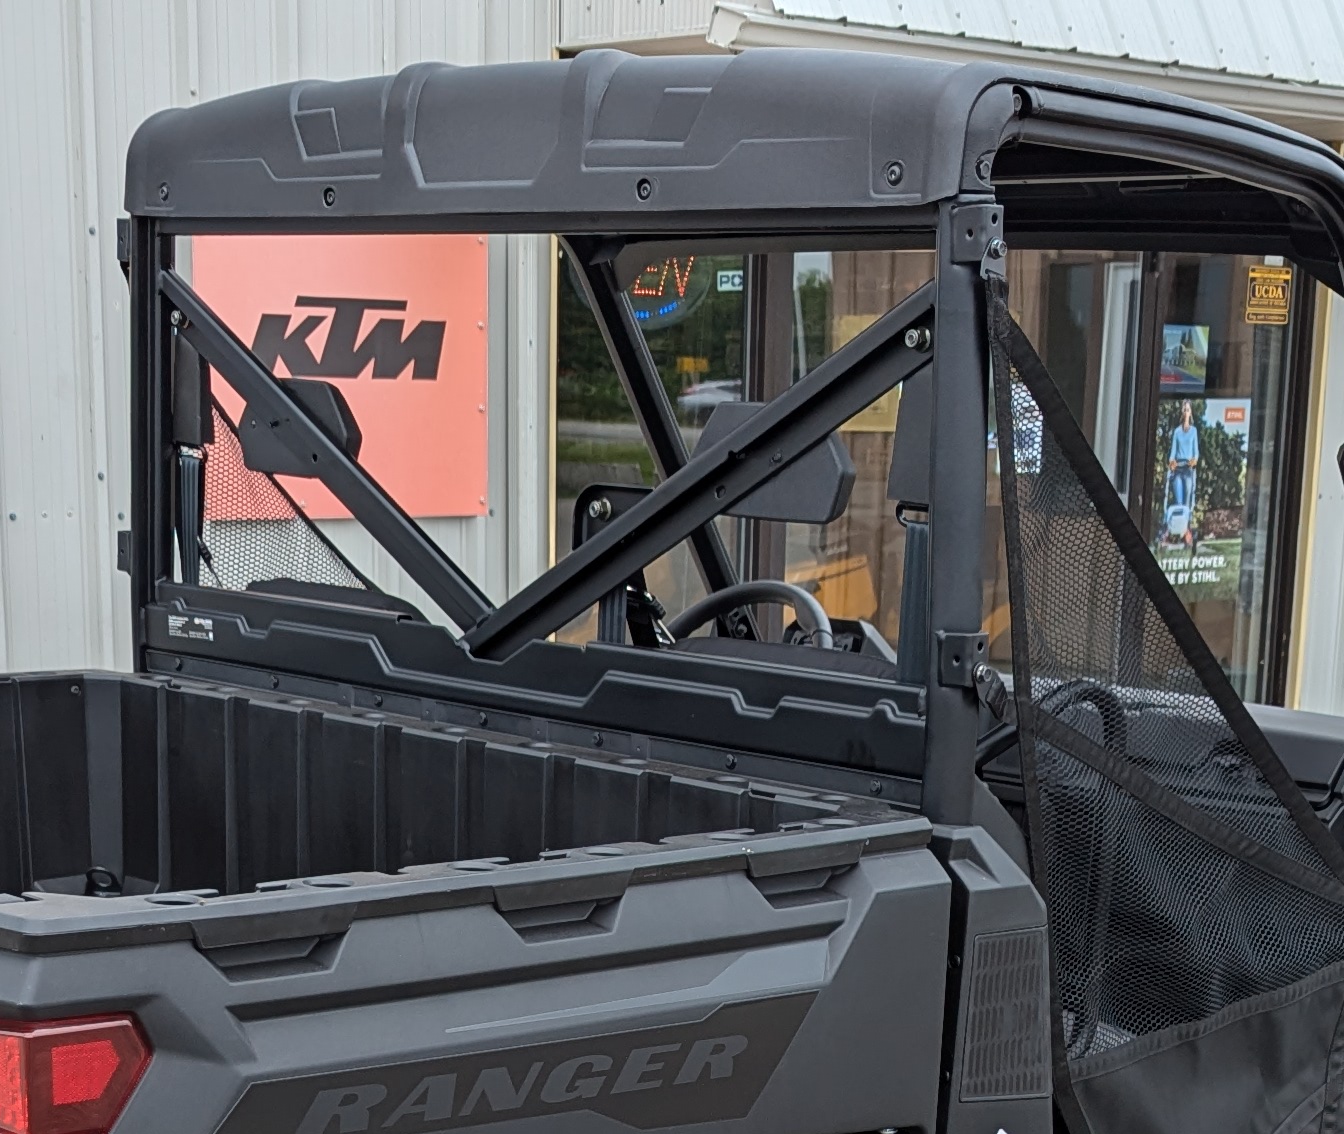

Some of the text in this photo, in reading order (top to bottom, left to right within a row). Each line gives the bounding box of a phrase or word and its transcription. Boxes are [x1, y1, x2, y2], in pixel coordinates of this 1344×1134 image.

[1255, 285, 1284, 299] UCDA
[251, 295, 447, 381] KTM
[1192, 555, 1227, 569] POWER.
[1178, 572, 1191, 584] BY
[1192, 570, 1220, 583] STIHL.
